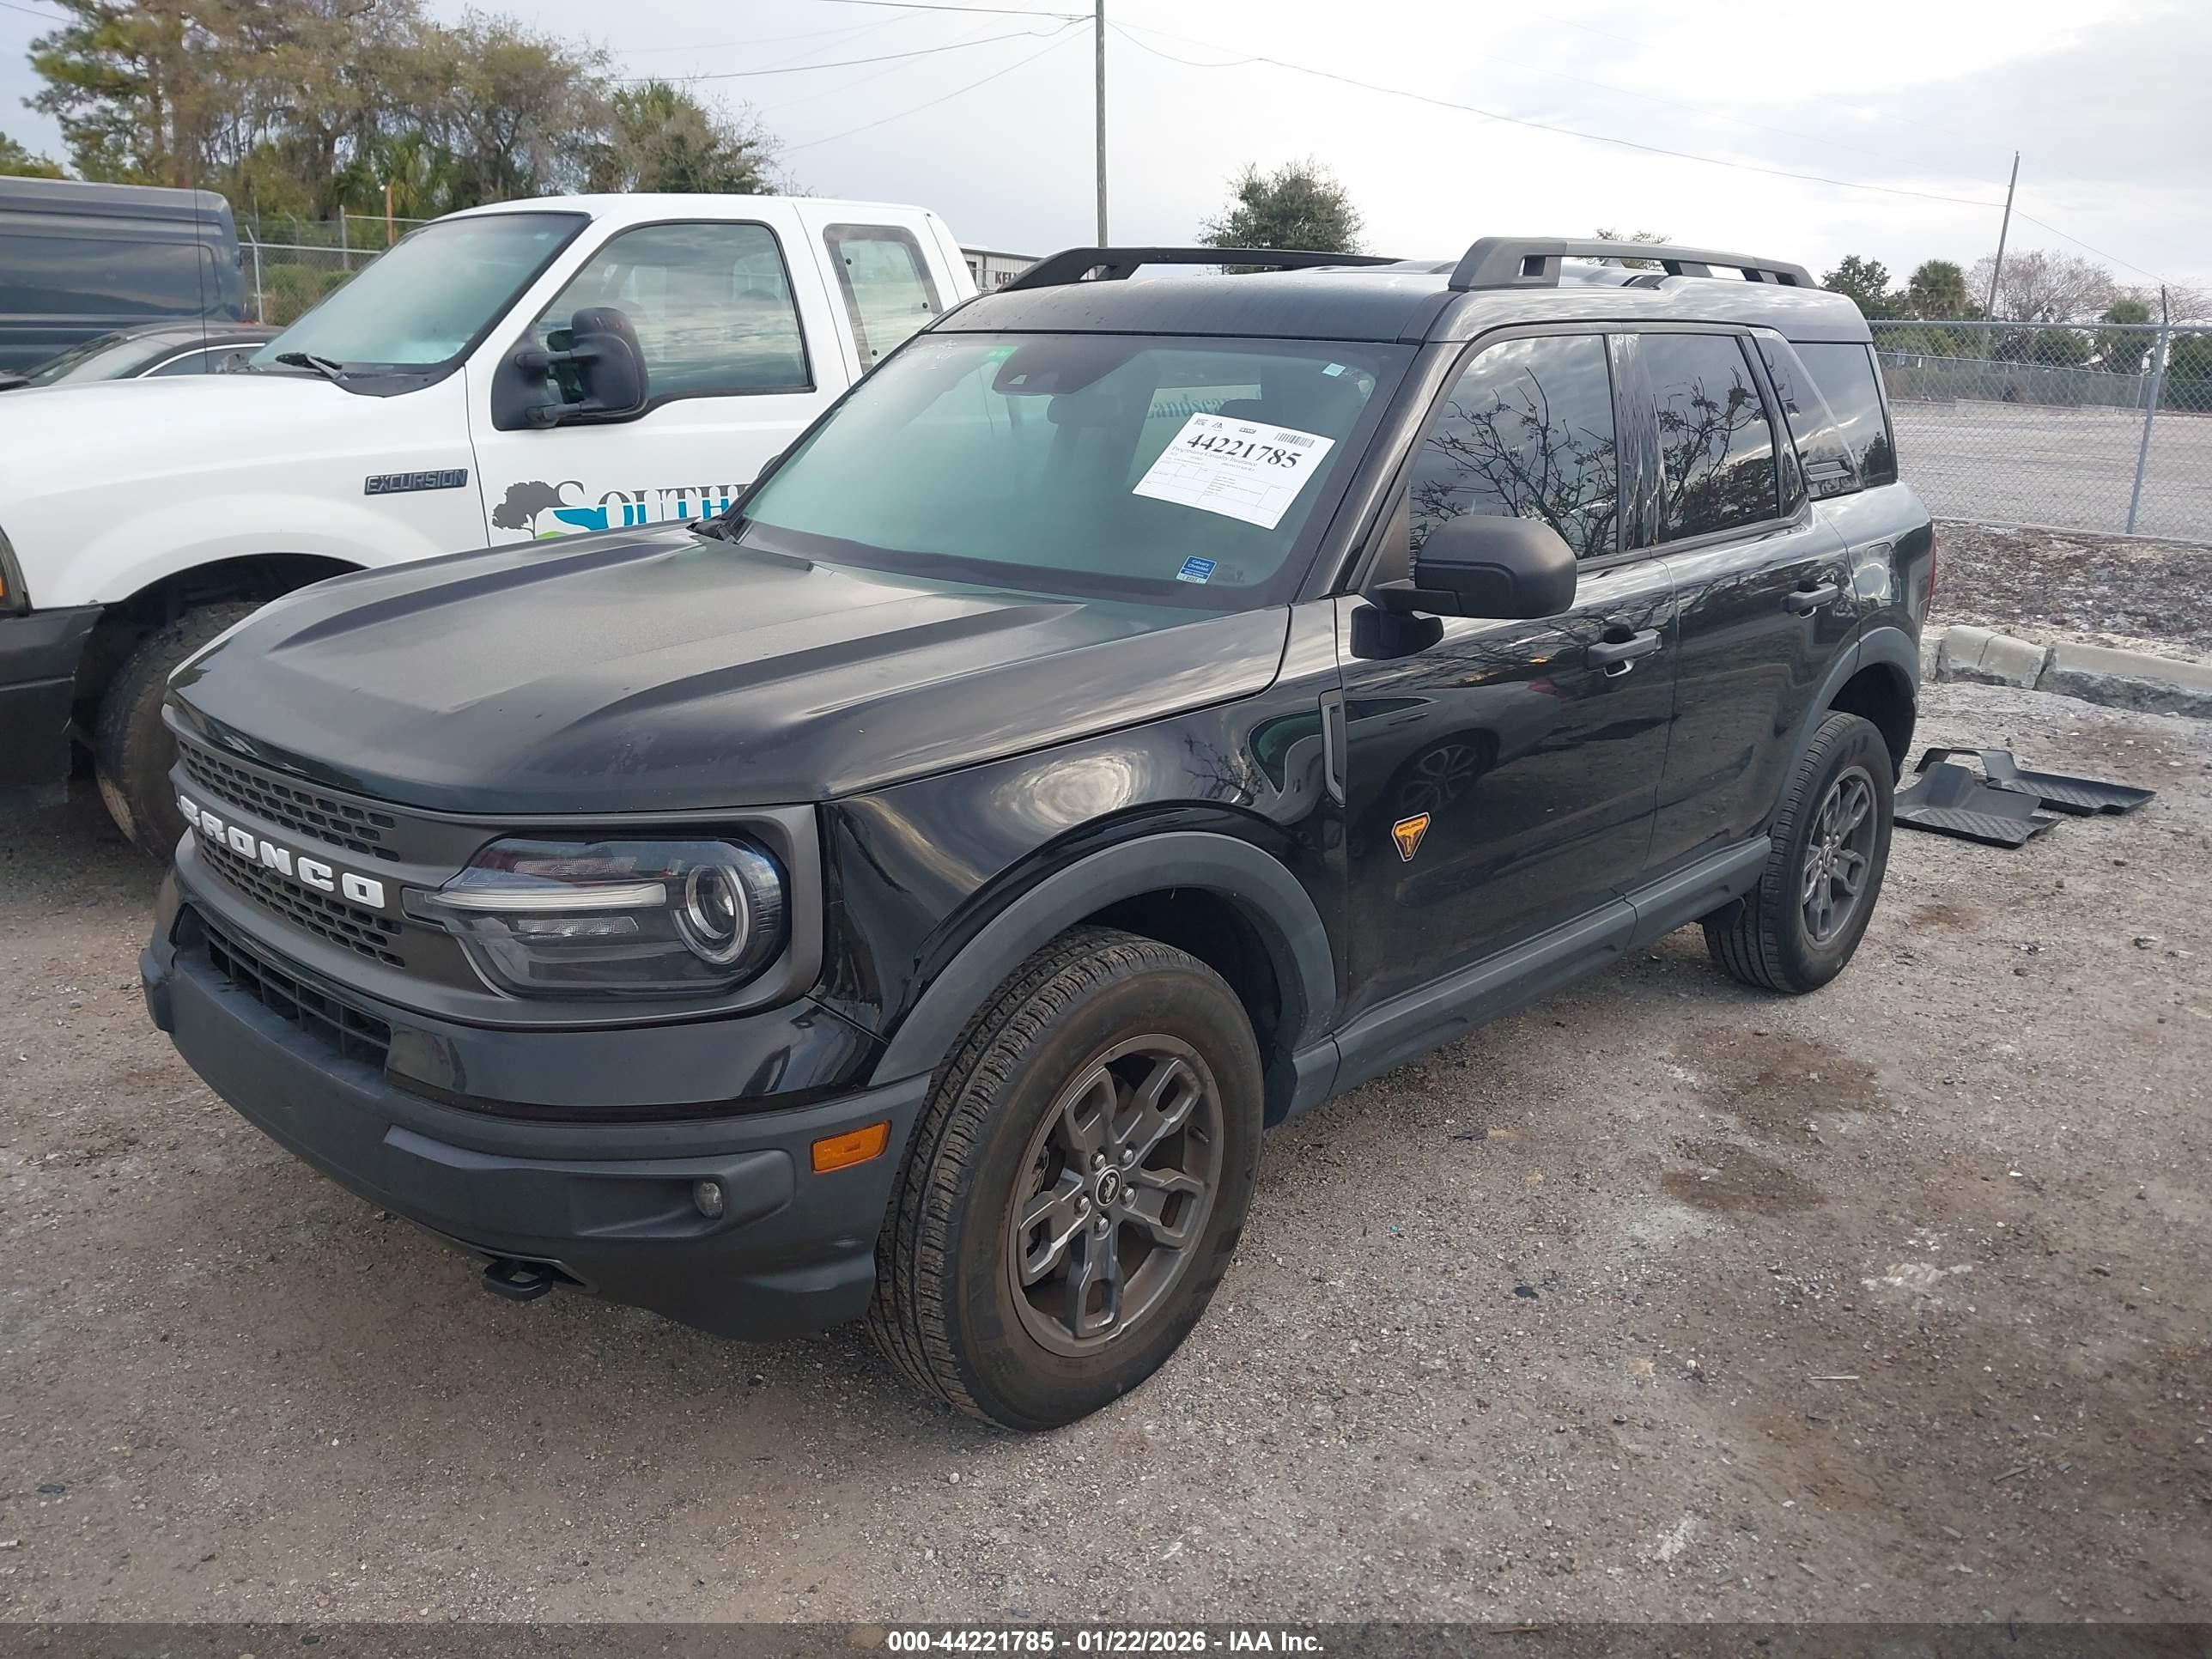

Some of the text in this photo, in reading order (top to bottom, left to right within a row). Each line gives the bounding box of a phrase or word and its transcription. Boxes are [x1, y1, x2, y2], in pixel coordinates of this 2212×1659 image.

[1187, 433, 1303, 468] 44221785
[366, 469, 467, 494] EXCURSION
[179, 795, 386, 908] BRONCO
